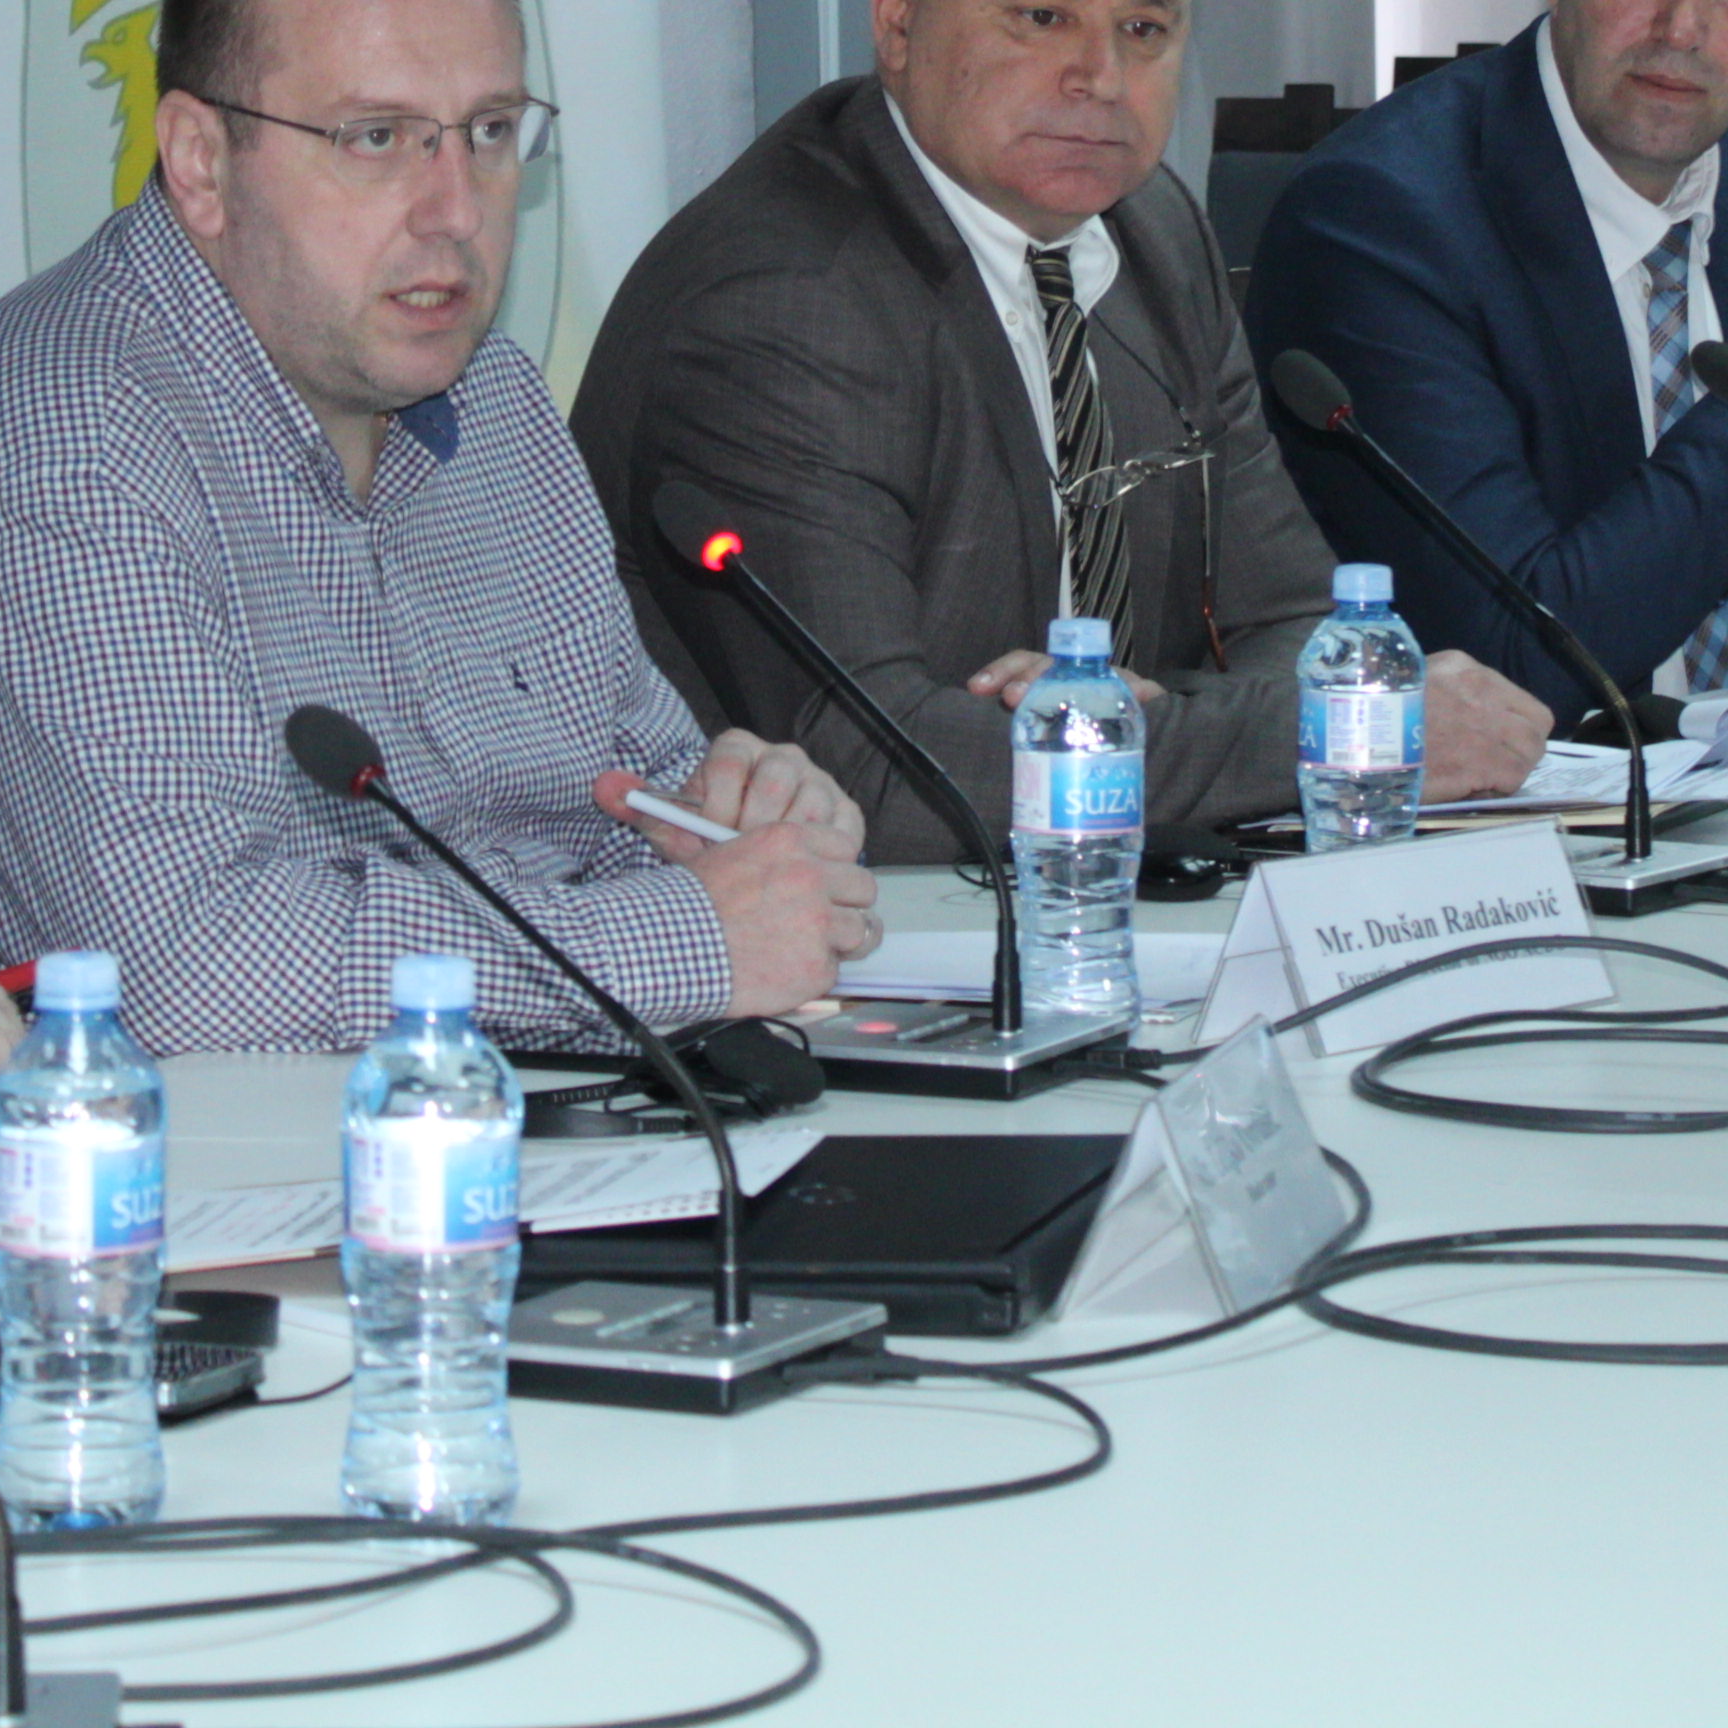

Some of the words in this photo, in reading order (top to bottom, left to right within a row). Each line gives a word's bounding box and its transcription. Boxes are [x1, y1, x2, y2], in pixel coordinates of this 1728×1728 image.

[1064, 788, 1138, 816] SUZA
[1316, 925, 1363, 956] Mr.
[1364, 913, 1439, 949] Dušan
[1441, 889, 1561, 935] Radaković
